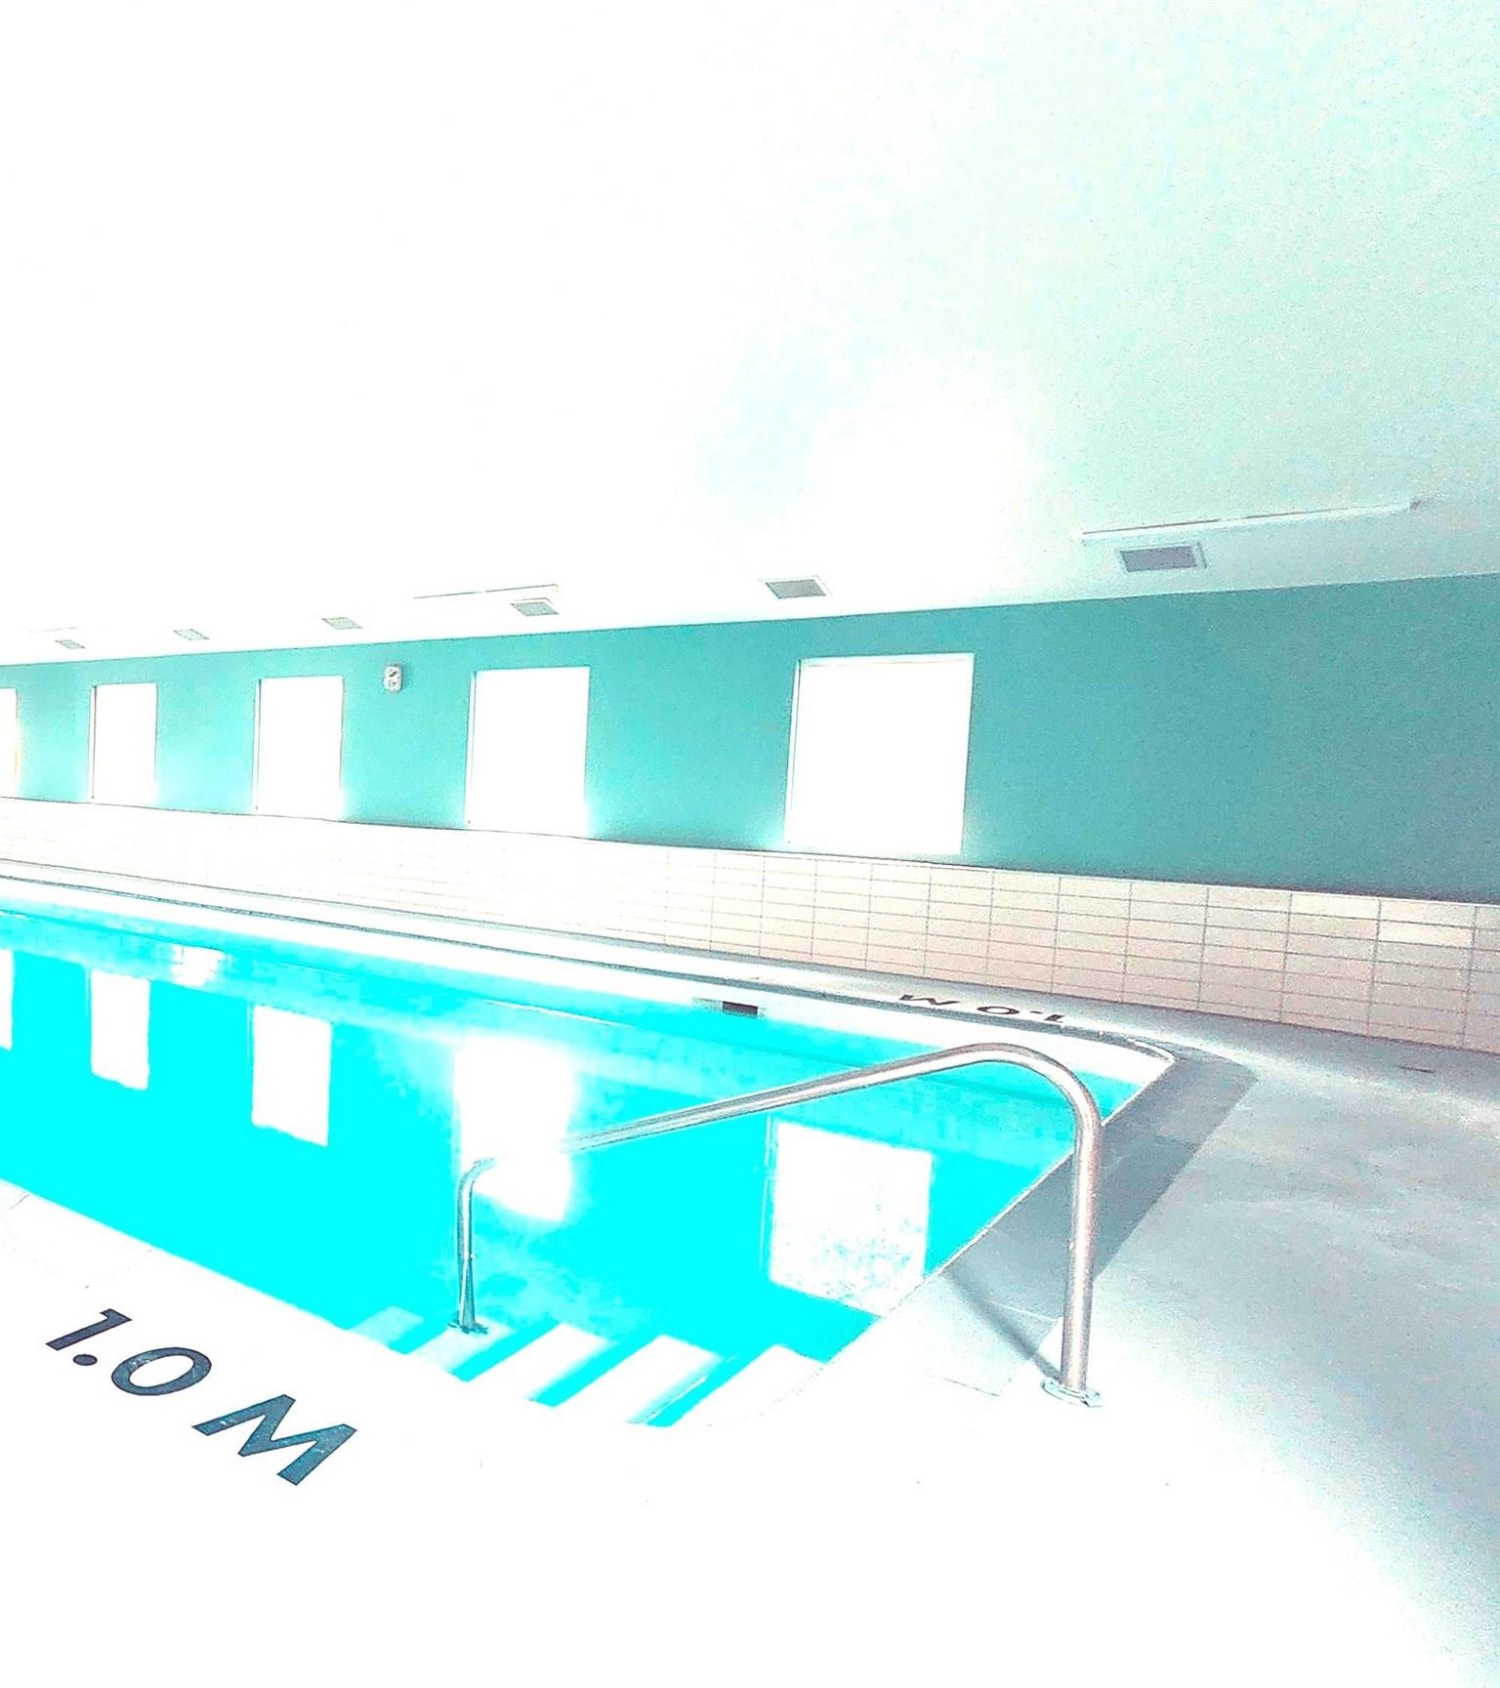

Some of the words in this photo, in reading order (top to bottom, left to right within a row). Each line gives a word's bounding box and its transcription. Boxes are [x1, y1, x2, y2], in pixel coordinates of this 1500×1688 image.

[899, 994, 961, 1005] M
[976, 1006, 1064, 1022] 1.0
[45, 1308, 212, 1396] 1.0
[191, 1394, 357, 1486] M
